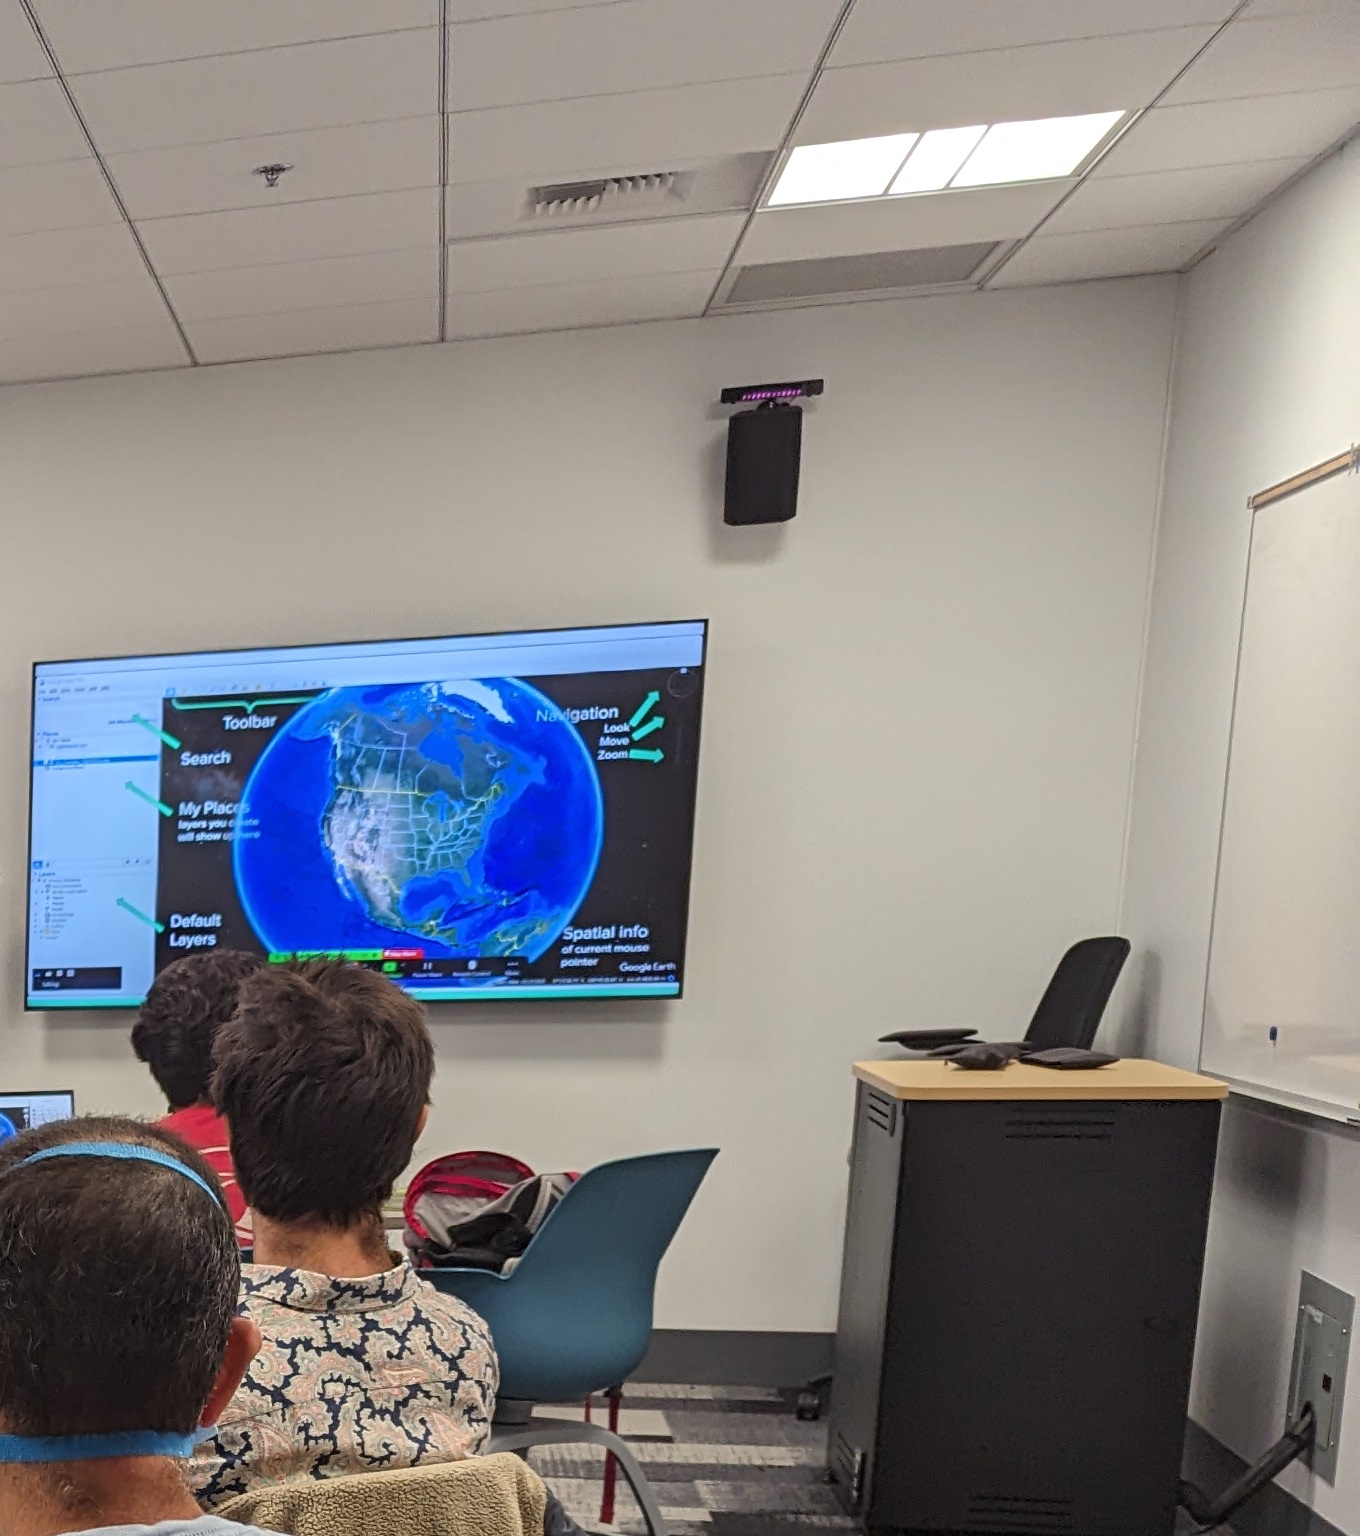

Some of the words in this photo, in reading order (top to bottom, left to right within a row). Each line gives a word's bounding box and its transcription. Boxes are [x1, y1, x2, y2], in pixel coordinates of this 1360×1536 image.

[536, 706, 619, 723] Navigation
[223, 715, 277, 730] Toolbar
[604, 723, 630, 733] Look
[599, 736, 629, 746] Move
[181, 750, 231, 766] Search
[597, 750, 628, 760] Zoom
[179, 802, 202, 818] My
[204, 801, 250, 815] Places
[178, 820, 207, 831] layers
[208, 820, 226, 829] you
[228, 817, 259, 826] cate
[177, 832, 194, 842] will
[195, 832, 221, 841] show
[240, 830, 260, 839] ere
[169, 914, 222, 928] Default
[563, 925, 615, 942] Spatial
[169, 933, 217, 949] Layers
[561, 945, 573, 954] of
[574, 944, 612, 954] current
[613, 944, 650, 953] mouse
[560, 957, 599, 969] pointer
[619, 962, 652, 973] Google
[653, 962, 676, 971] Earth
